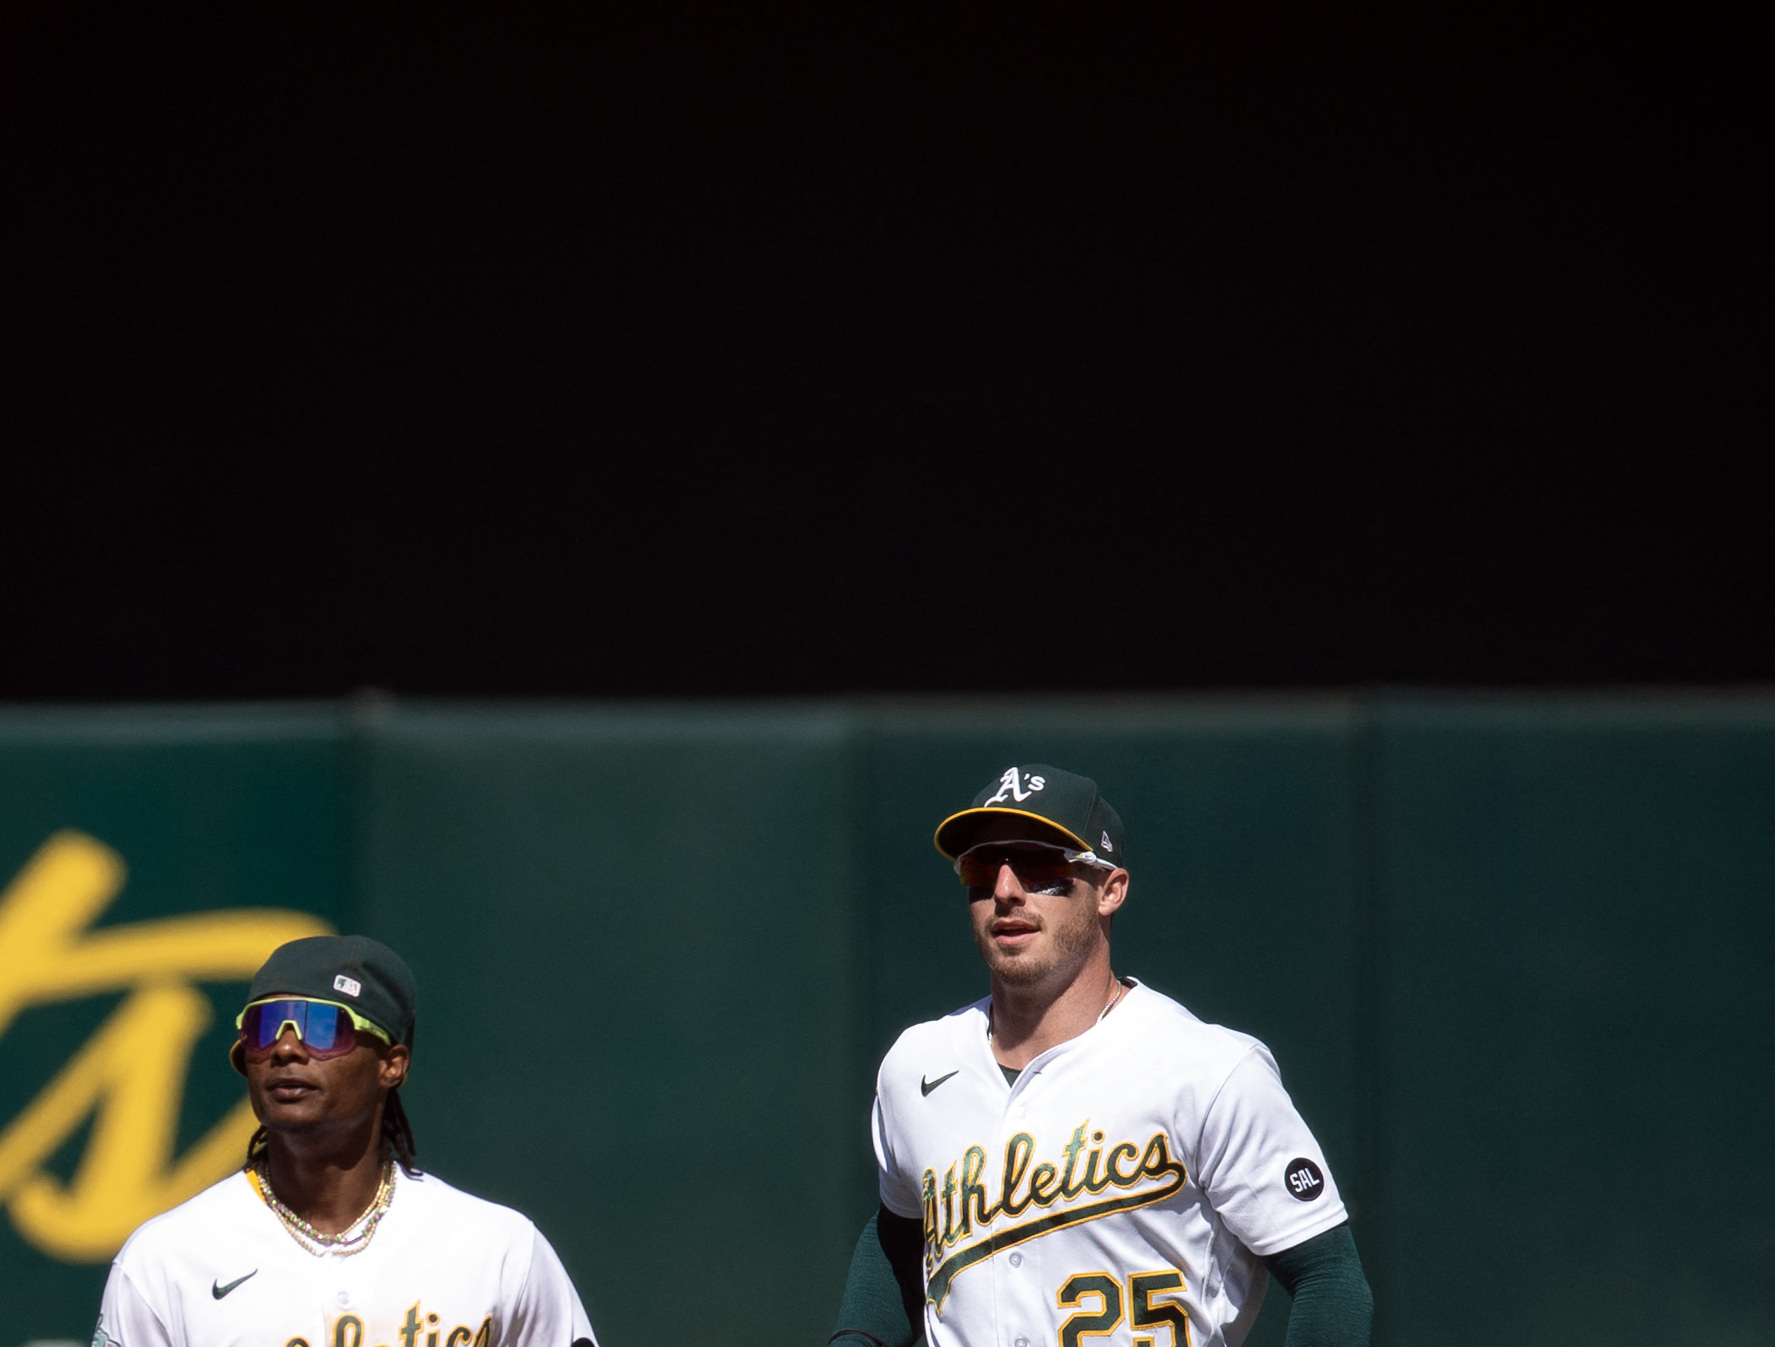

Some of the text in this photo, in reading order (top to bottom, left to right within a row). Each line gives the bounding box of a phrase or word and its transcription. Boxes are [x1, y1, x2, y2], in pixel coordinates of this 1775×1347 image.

[984, 766, 1046, 808] A's
[923, 1117, 1188, 1273] Athletics
[1289, 1167, 1320, 1193] SAL
